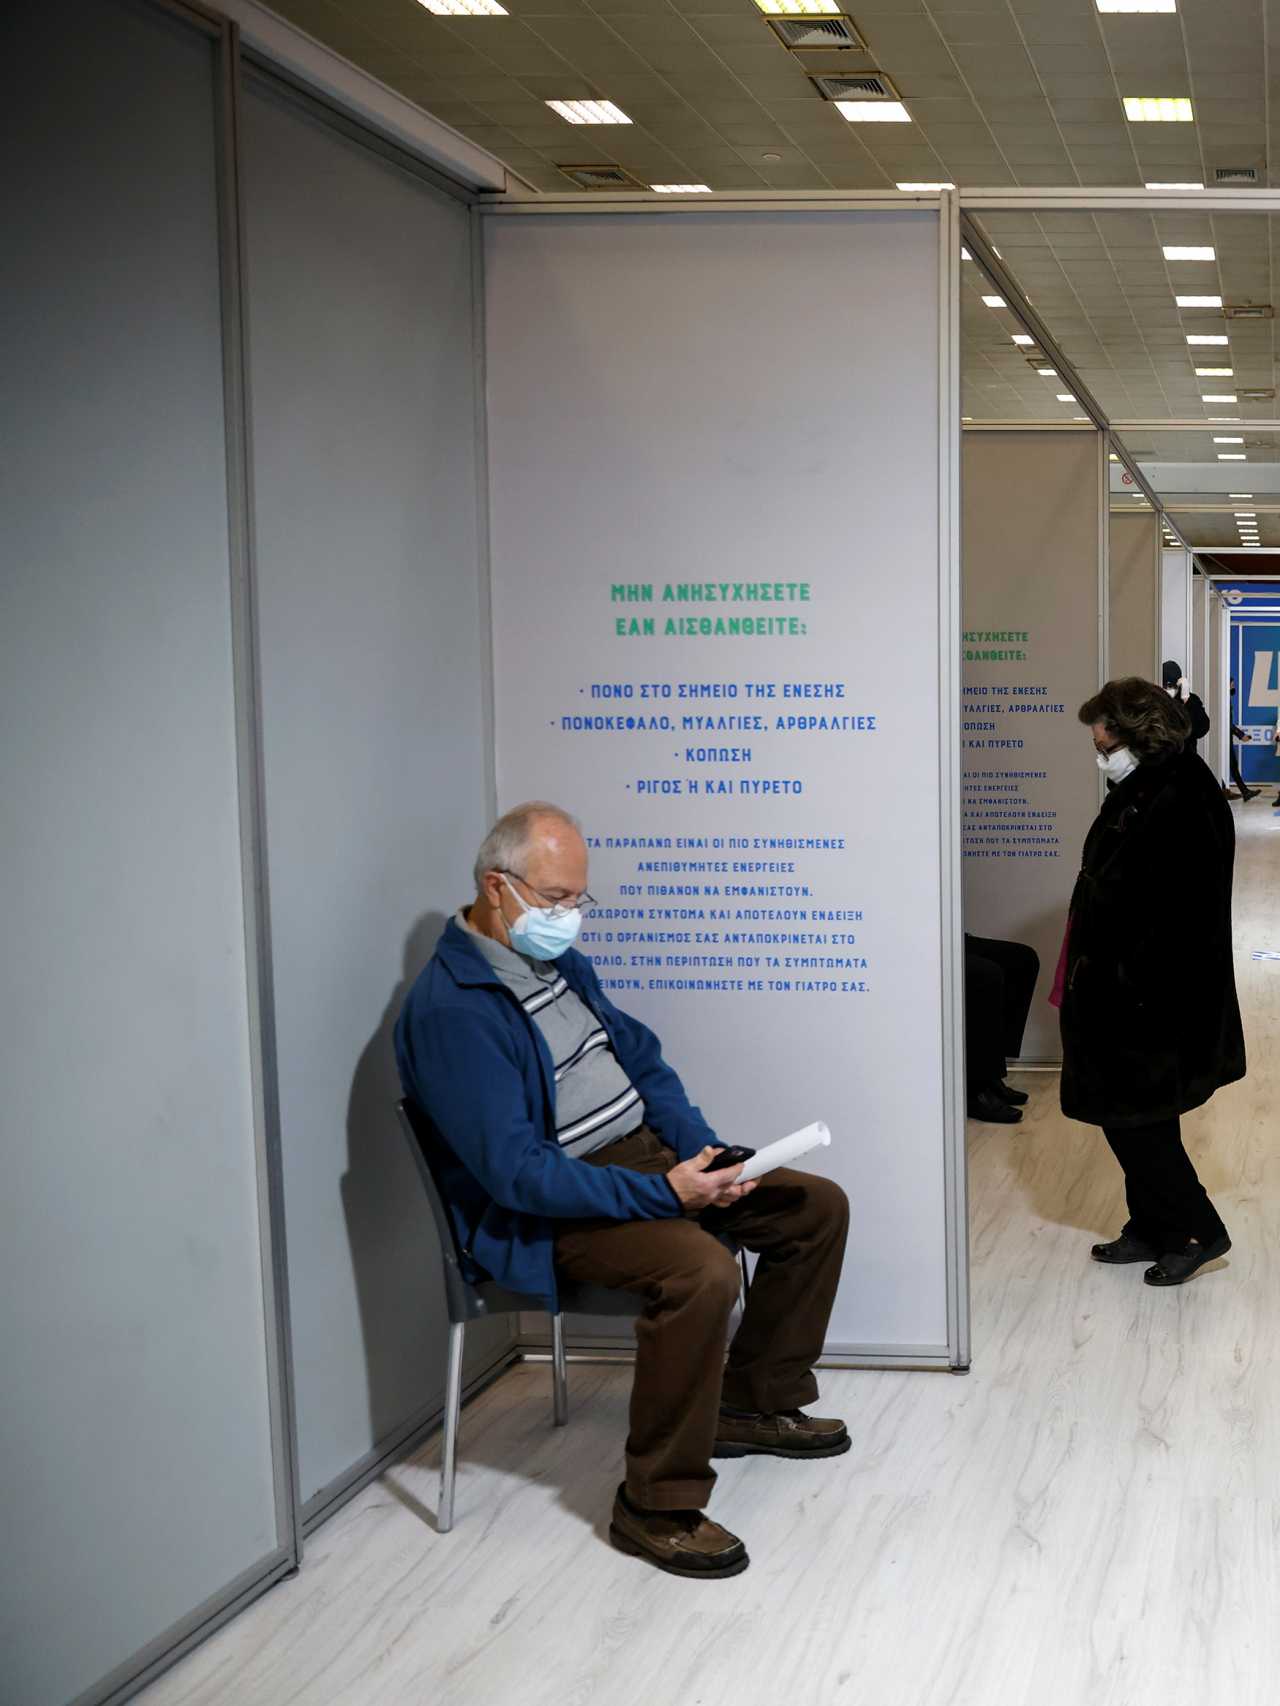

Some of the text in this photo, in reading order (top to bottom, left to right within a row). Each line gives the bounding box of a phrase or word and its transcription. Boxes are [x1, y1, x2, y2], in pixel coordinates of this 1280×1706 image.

[611, 583, 810, 602] ΜΗΝ ΑΝΗΣΥΧΗΣΕΤΕ
[616, 617, 807, 636] ΕΑΝ ΑΙΣΘΑΝΘΕΙΤΕ:
[591, 684, 845, 698] ΠΟΝΟ ΣΤΟ ΣΗΜΕΙΟ ΤΗΣ ΕΝΕΣΗΣ
[992, 687, 1009, 696] ΤΗΣ
[1012, 687, 1048, 696] ΕΝΕΣΗΣ
[1008, 704, 1065, 713] ΑΡΘΡΑΛΓΙΕΣ
[562, 716, 876, 732] ΠΟΝΟΚΕΦΑΛΟ, ΜΥΑΛΓΙΕΣ, ΑΡΘΡΑΛΓΙΕΣ
[969, 740, 985, 748] ΚΑΙ
[988, 740, 1024, 748] ΠΥΡΕΤΟ
[686, 748, 752, 762] ΚΟΠΩΣΗ
[637, 780, 682, 794] ΡΙΓΟΣ
[705, 780, 732, 794] ΚΑΙ
[740, 780, 802, 794] ΠΥΡΕΤΟ
[587, 838, 845, 849] ΤΑ ΠΑΡΑΠΑΝΩ ΕΙΝΑΙ ΟΙ ΠΙΟ ΣΥΝΗΘΙΣΜΕΝΕΣ
[638, 862, 795, 872] ΑΝΕΠΙΘΥΜΗΤΕΣ ΕΝΕΡΓΕΙΕΣ
[620, 886, 813, 896] ΠΟΥ ΠΙΘΑΝΟΝ ΝΑ ΕΜΦΑΝΙΣΤΟΥΝ.
[649, 909, 705, 919] ΣΥΝΤΟΜΑ
[710, 909, 730, 919] ΚΑΙ
[736, 909, 806, 920] ΑΠΟΤΕΛΟΥΝ
[812, 910, 863, 921] ΕΝΔΕΙΞΗ
[582, 932, 855, 944] ΟΤΙ Ο ΟΡΓΑΝΙΣΜΟΣ ΣΑΣ ΑΝΤΑΠΟΚΡΙΝΕΤΑΙ ΣΤΟ
[631, 956, 662, 966] ΣΤΗΝ
[666, 956, 733, 966] ΠΕΡΙΠΤΩΣΗ
[737, 957, 760, 967] ΠΟΥ
[765, 957, 780, 967] ΤΑ
[785, 958, 868, 968] ΣΥΜΠΤΩΜΑΤΑ
[649, 980, 743, 990] ΕΠΙΚΟΙΝΩΝΗΣΤΕ
[748, 981, 763, 990] ΜΕ
[768, 981, 790, 991] ΤΟΝ
[795, 981, 837, 991] ΓΙΑΤΡΟ
[841, 982, 869, 992] ΣΑΣ.
